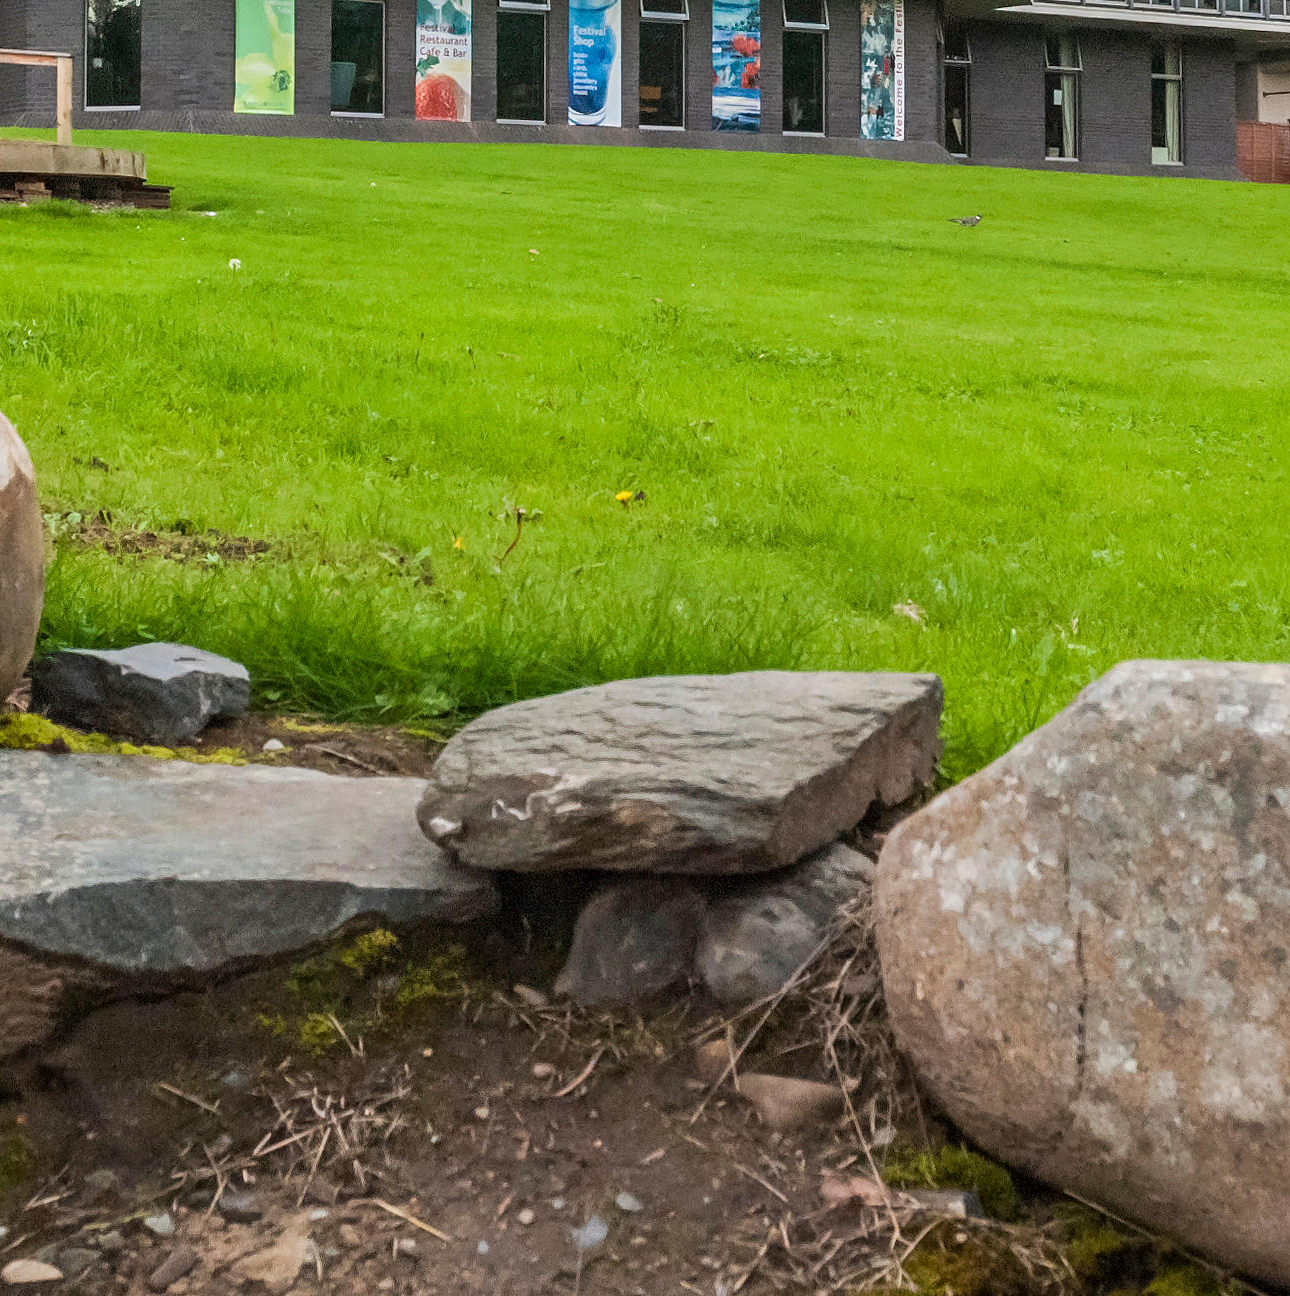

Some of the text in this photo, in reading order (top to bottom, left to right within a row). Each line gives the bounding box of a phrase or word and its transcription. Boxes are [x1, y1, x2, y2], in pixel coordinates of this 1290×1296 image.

[420, 23, 455, 32] Festival
[573, 25, 606, 36] Festival
[420, 35, 468, 46] Restaurant
[573, 35, 594, 48] Shop
[444, 48, 450, 56] &
[453, 49, 467, 57] Bar
[895, 38, 903, 58] the
[895, 62, 903, 74] to
[895, 80, 903, 138] Welcome
